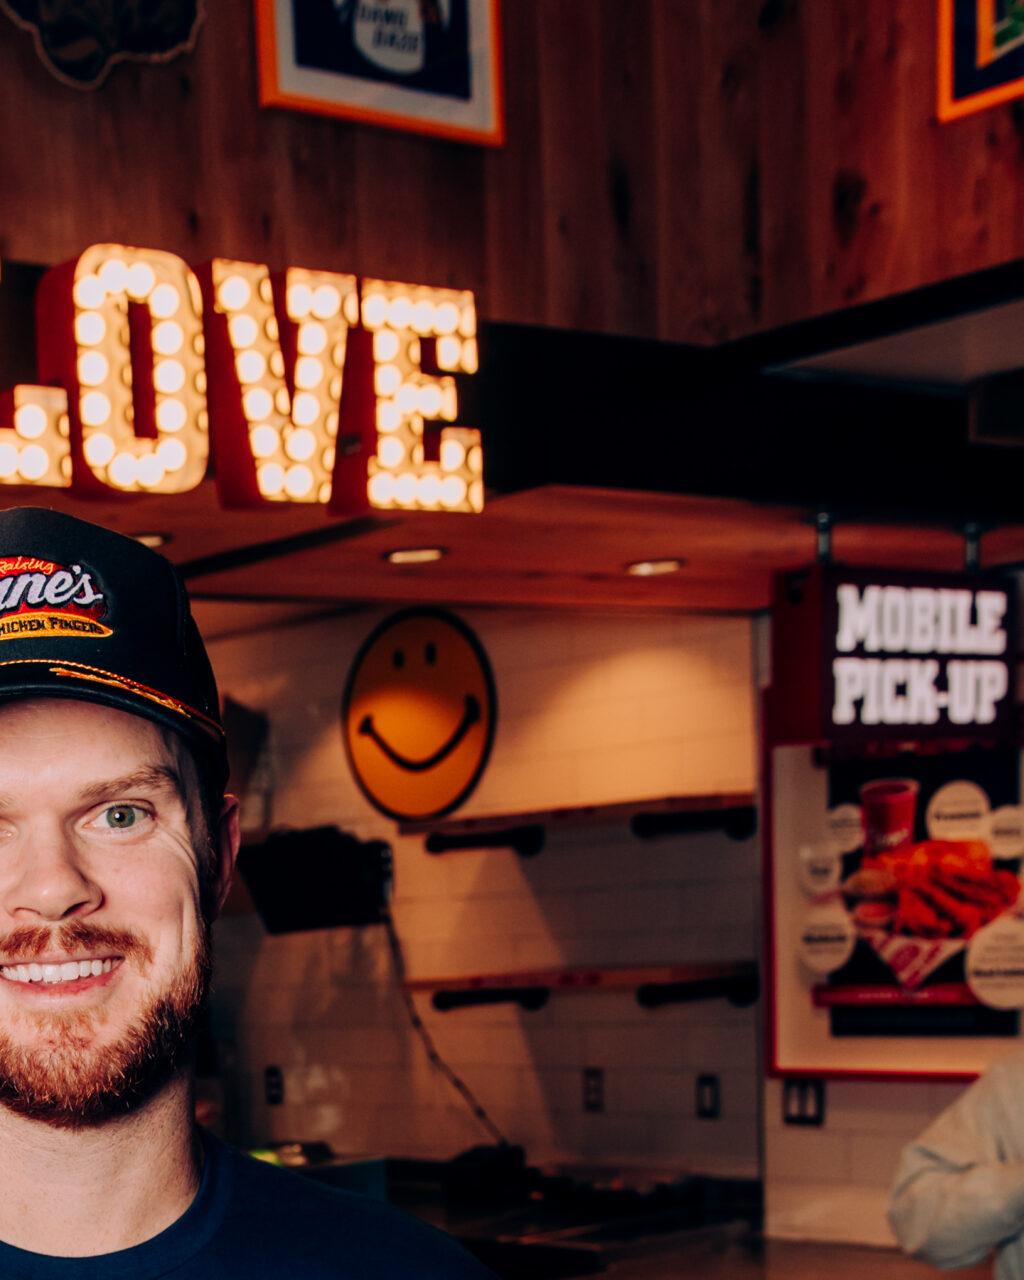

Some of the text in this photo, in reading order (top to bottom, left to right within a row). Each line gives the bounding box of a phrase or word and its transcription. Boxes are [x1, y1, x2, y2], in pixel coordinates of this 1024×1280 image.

[47, 616, 105, 635] FINGERS
[835, 583, 1008, 656] MOBILE
[832, 656, 1009, 726] PICK-UP
